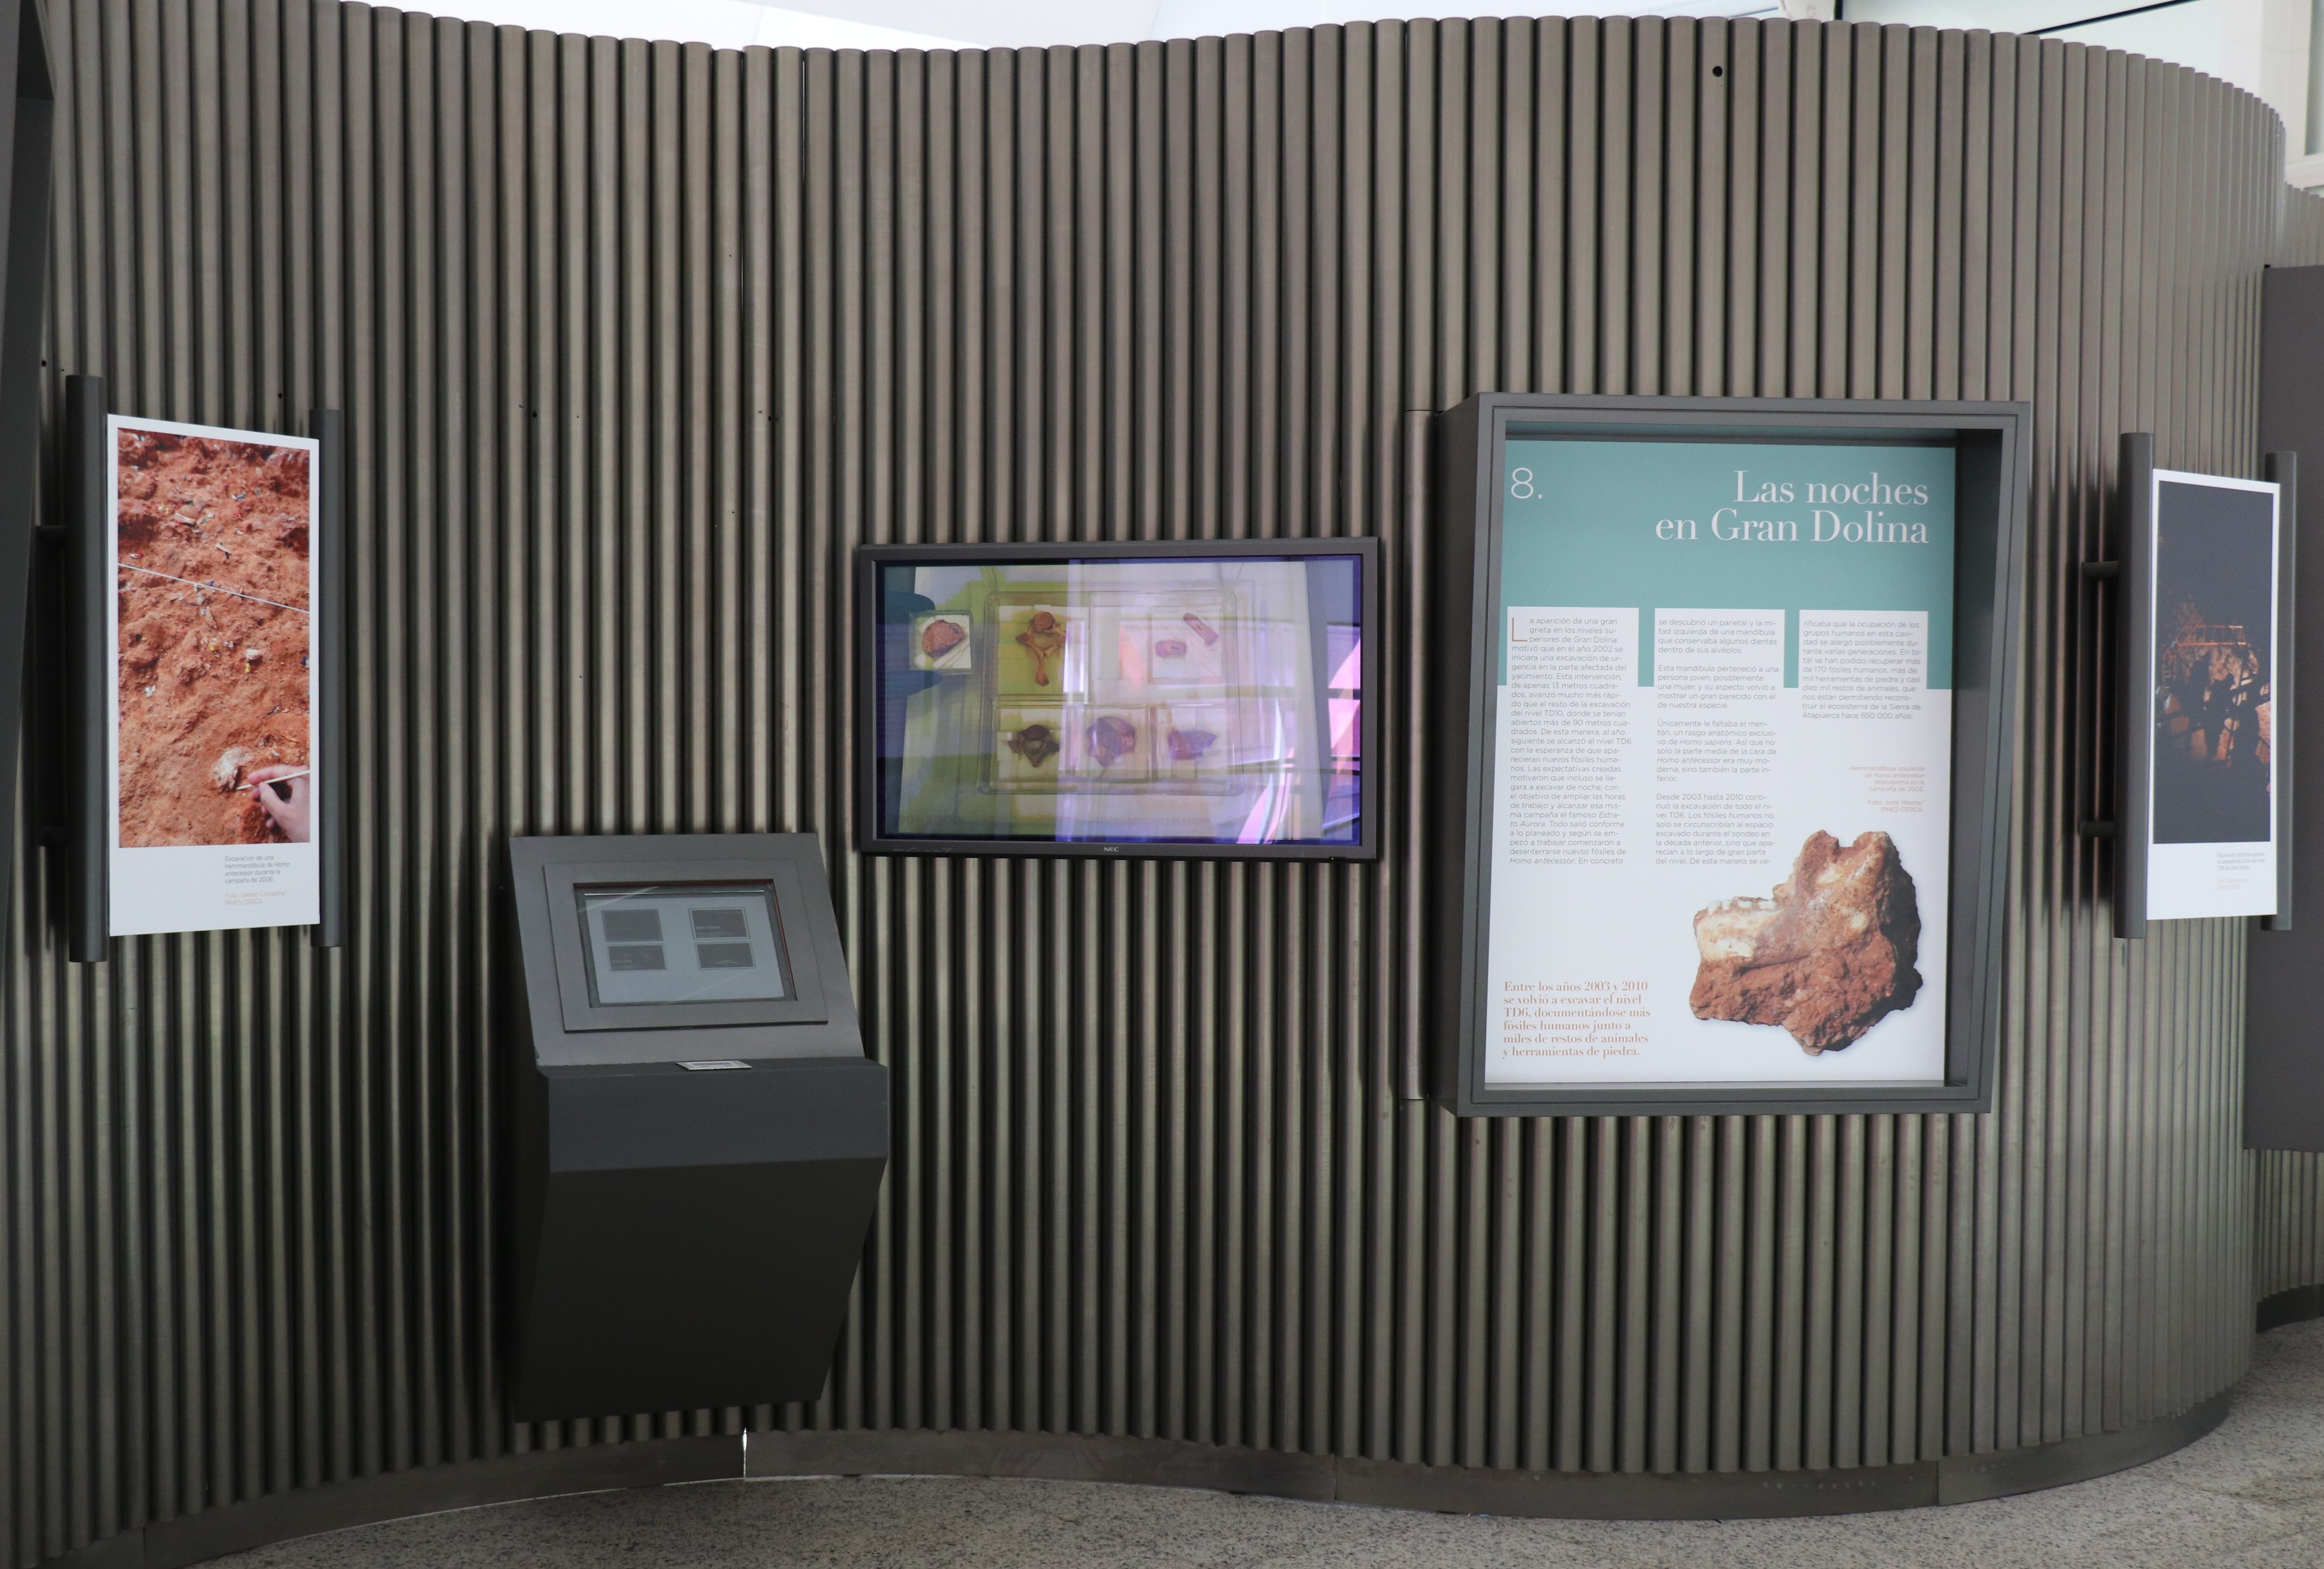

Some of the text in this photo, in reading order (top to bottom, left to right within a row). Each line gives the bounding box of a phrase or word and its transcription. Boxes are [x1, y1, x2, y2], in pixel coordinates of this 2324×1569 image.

[1511, 468, 1542, 499] 8.
[1734, 470, 1928, 505] Las noches
[1656, 508, 1928, 543] en Gran Dolina
[1717, 665, 1757, 673] perteneció
[1511, 672, 1554, 681] yacimiento.
[1505, 981, 1648, 994] Entre los años 2003 y 2010
[1518, 994, 1549, 1004] volvió
[1604, 994, 1613, 1004] el
[1617, 994, 1641, 1004] nivel
[1504, 1007, 1651, 1018] TD6, documentándose más
[1504, 1020, 1537, 1030] fósiles
[1540, 1020, 1590, 1030] humanos
[1592, 1020, 1622, 1032] junto
[1504, 1033, 1532, 1043] miles
[1535, 1033, 1547, 1043] de
[1585, 1032, 1598, 1042] de
[1601, 1033, 1649, 1043] animales
[1502, 1046, 1639, 1058] y herramientas de piedra.
